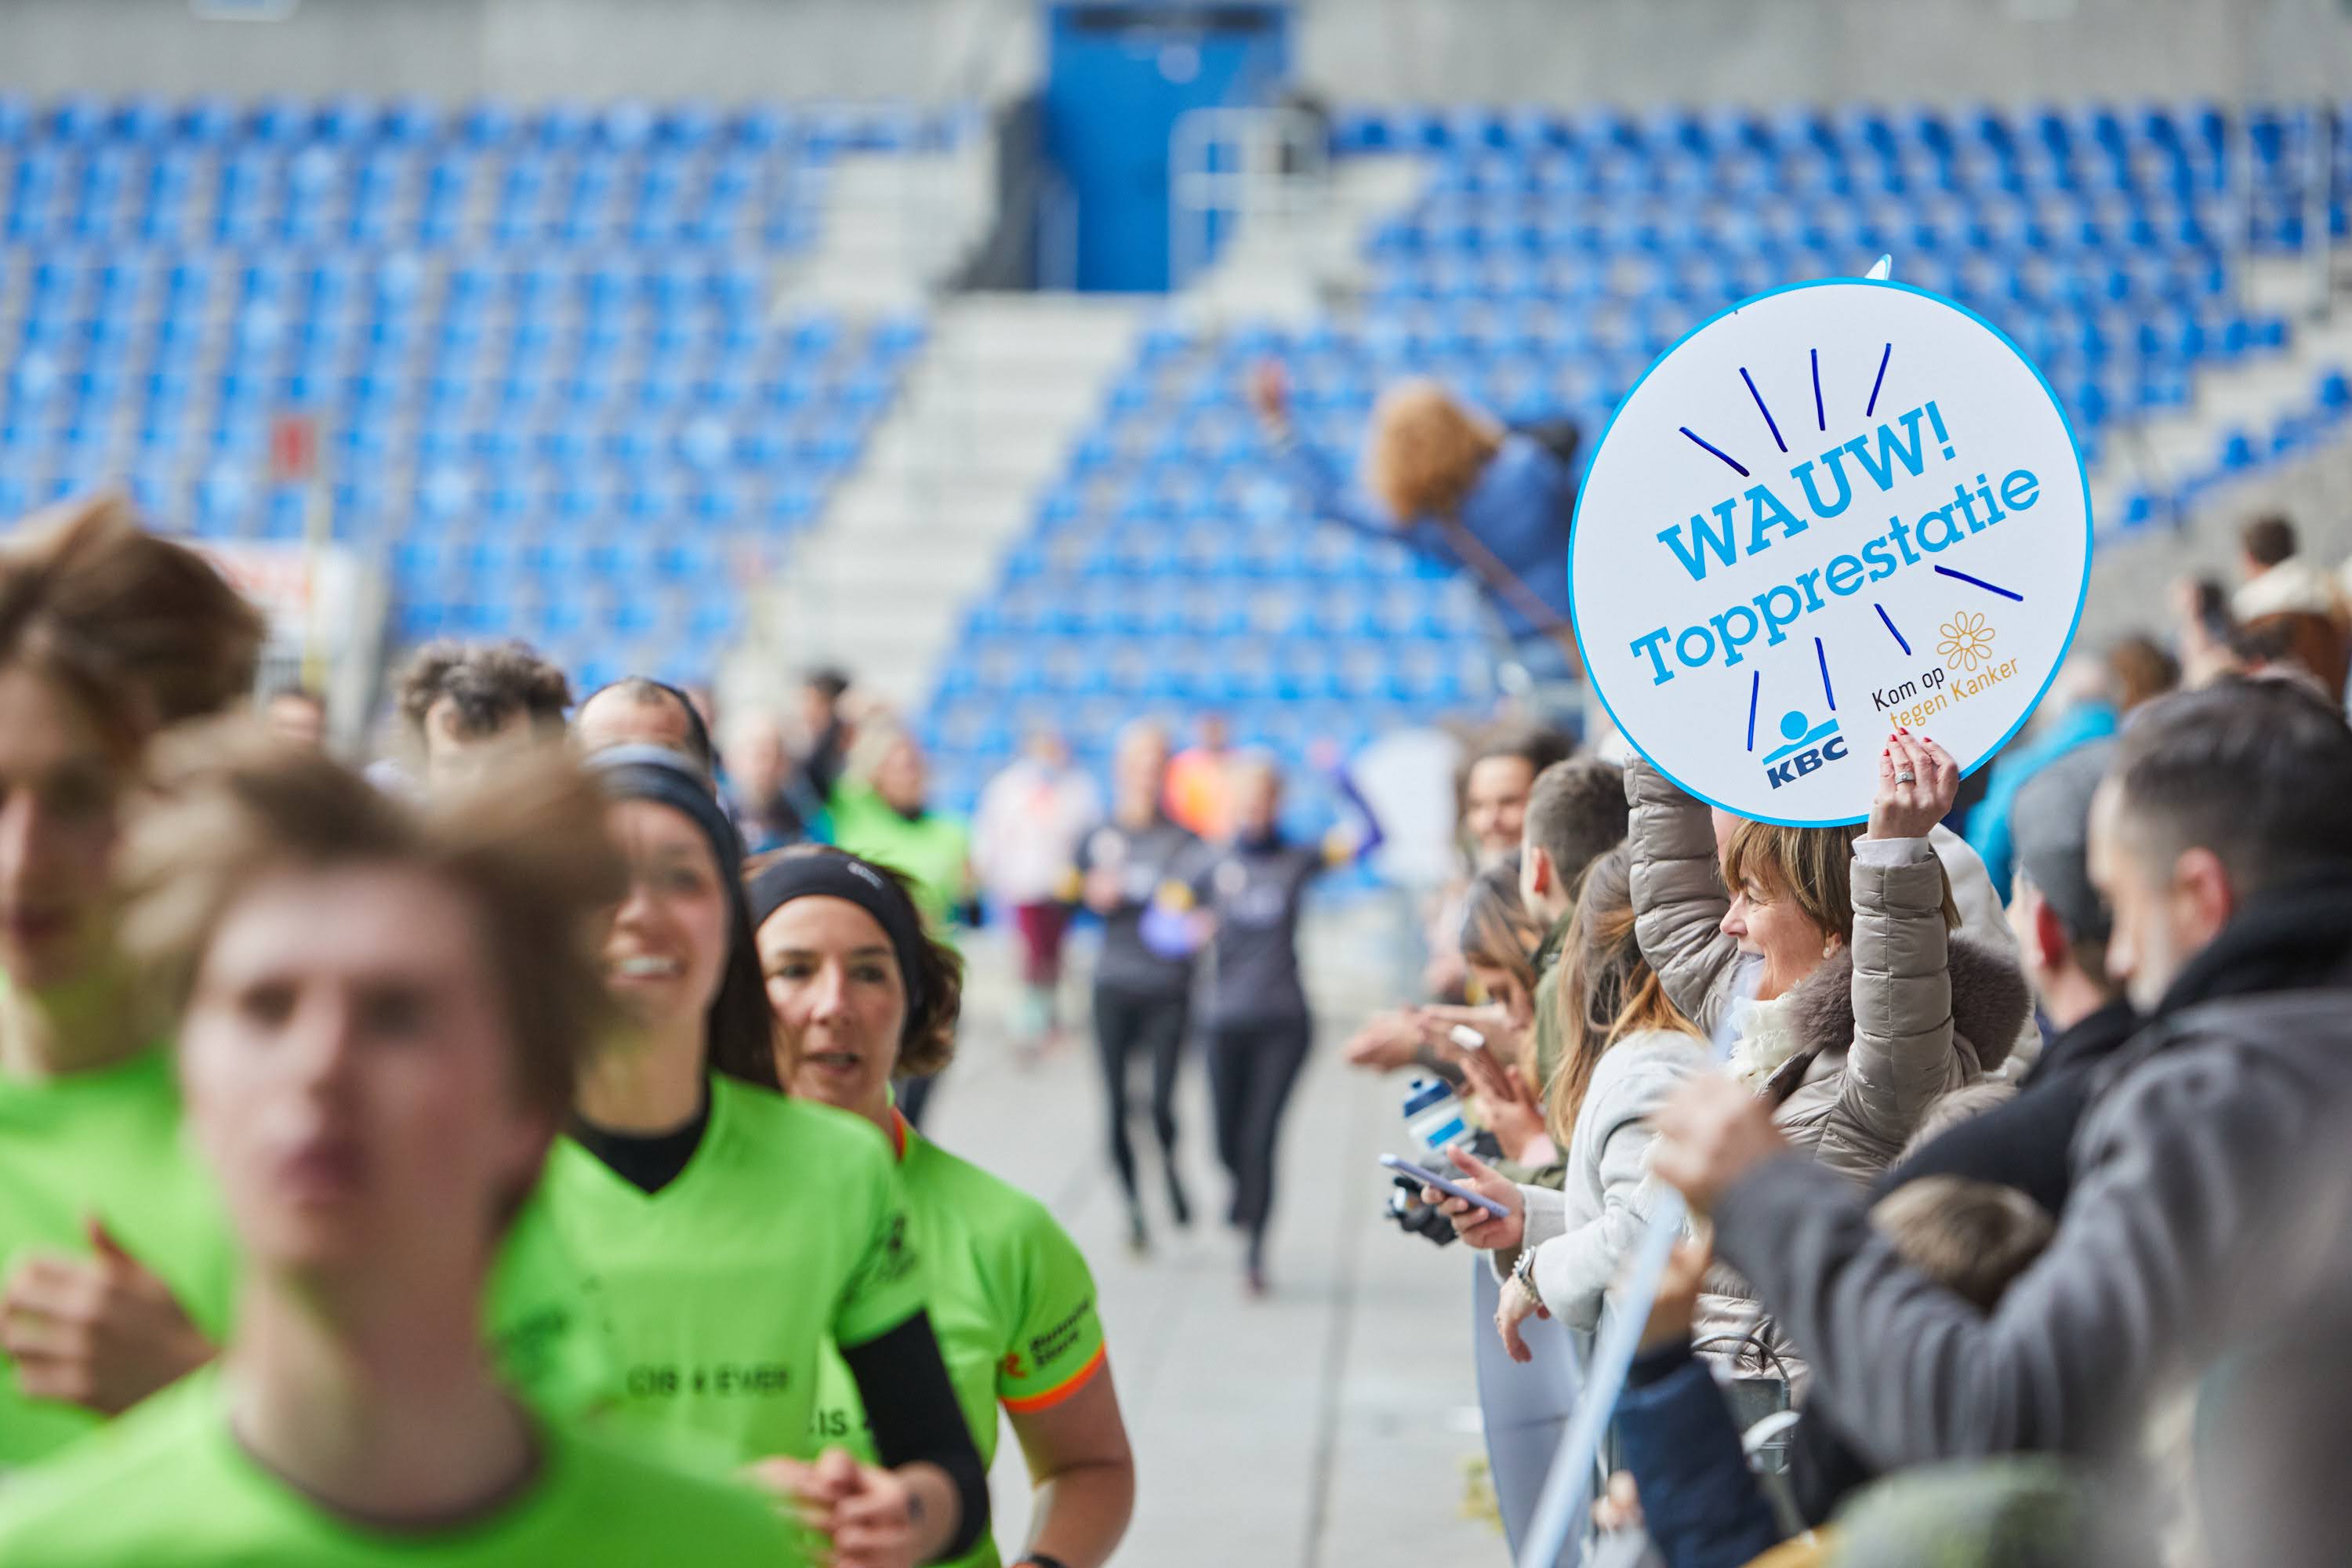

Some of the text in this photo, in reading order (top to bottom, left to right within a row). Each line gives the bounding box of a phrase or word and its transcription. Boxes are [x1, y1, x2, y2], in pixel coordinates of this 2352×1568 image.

[1656, 400, 1957, 582] WAUW!
[1630, 468, 2040, 687] Topprestatie
[1871, 667, 1945, 712] Kom op
[1890, 658, 2019, 729] tegen Kanker
[1766, 735, 1849, 790] KBC
[808, 1410, 850, 1436] IS
